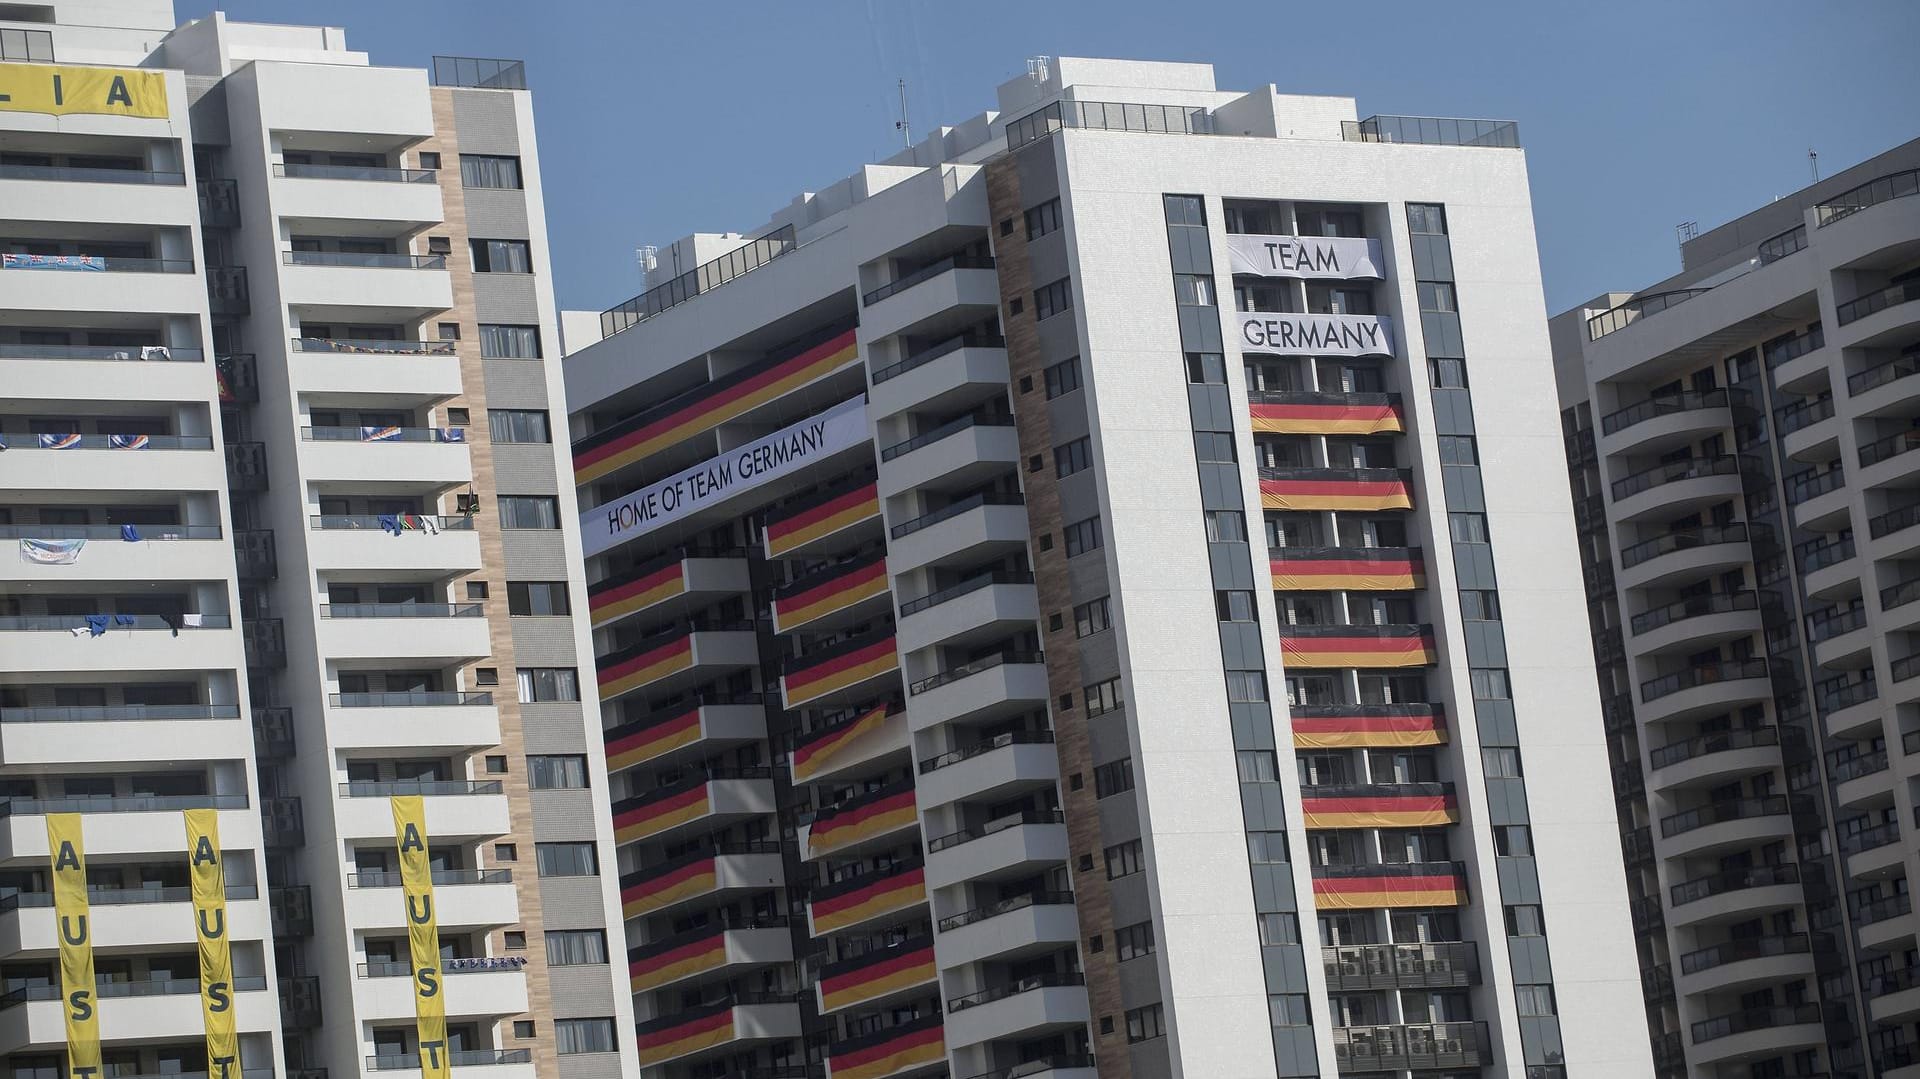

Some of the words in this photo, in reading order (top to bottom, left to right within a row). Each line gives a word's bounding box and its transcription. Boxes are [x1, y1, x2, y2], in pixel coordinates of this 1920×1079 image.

[0, 75, 133, 106] IA
[1264, 242, 1340, 272] TEAM
[1243, 319, 1378, 349] GERMANY
[608, 493, 658, 535] HOME
[661, 481, 684, 512] OF
[687, 459, 733, 501] TEAM
[738, 421, 825, 479] GERMANY
[401, 822, 444, 1070] AUST
